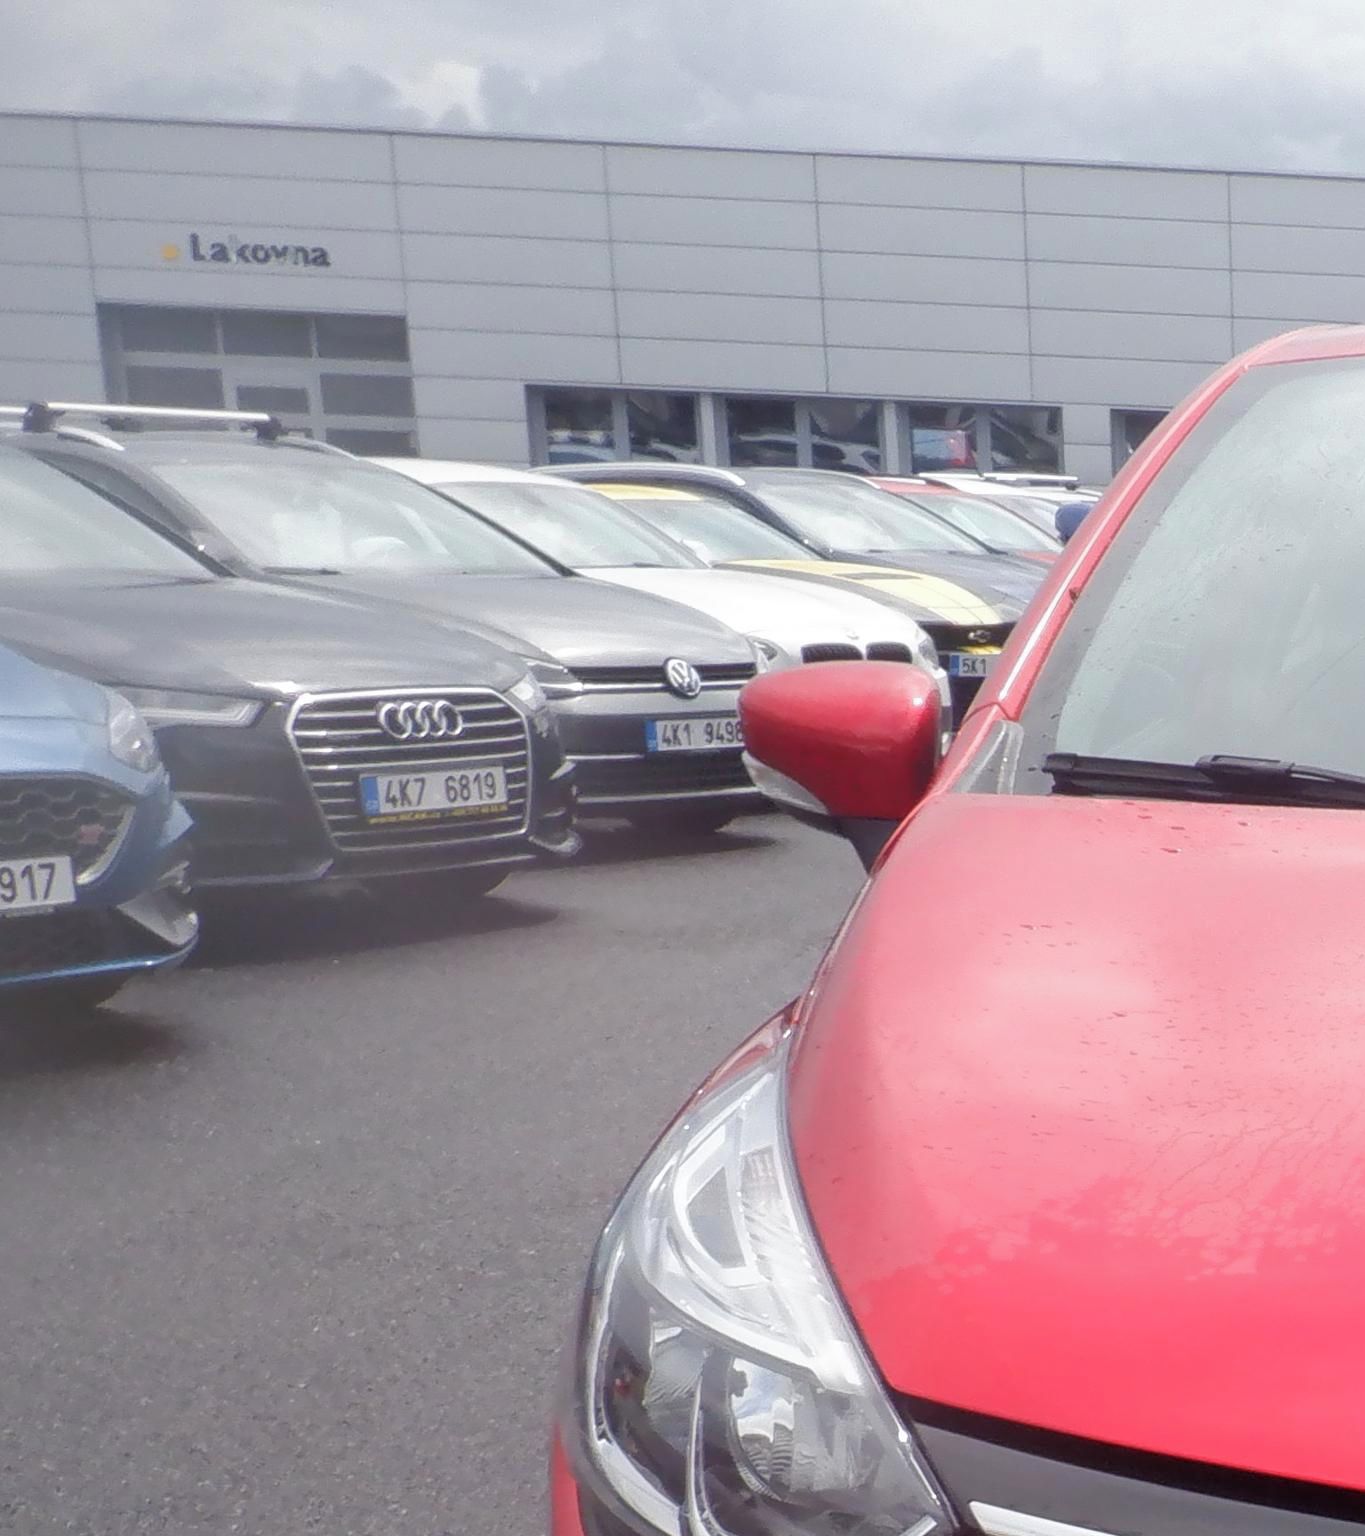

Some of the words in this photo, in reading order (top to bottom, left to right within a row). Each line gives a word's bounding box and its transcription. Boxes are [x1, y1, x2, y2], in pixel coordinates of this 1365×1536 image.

[190, 233, 331, 267] Lakovna
[962, 658, 986, 674] 5K1
[661, 723, 692, 746] 4K1
[385, 777, 426, 808] 4K7
[444, 771, 497, 802] 6819
